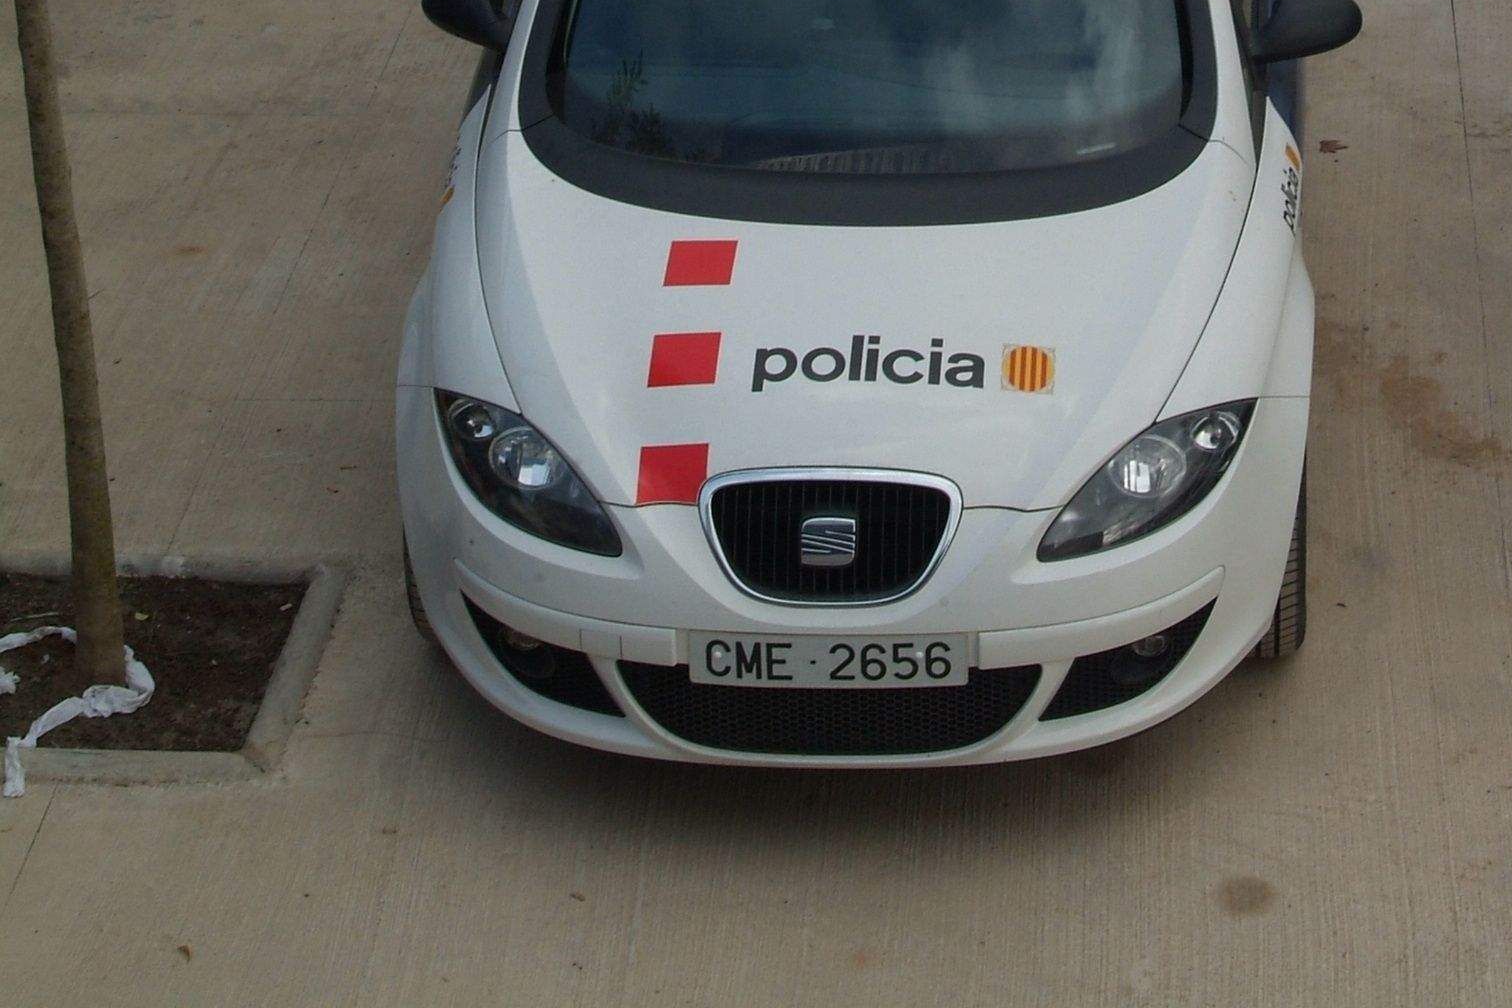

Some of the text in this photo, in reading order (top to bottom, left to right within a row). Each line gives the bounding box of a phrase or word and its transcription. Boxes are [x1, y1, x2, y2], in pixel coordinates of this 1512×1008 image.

[751, 335, 985, 392] policia
[705, 639, 951, 682] CME 2656
